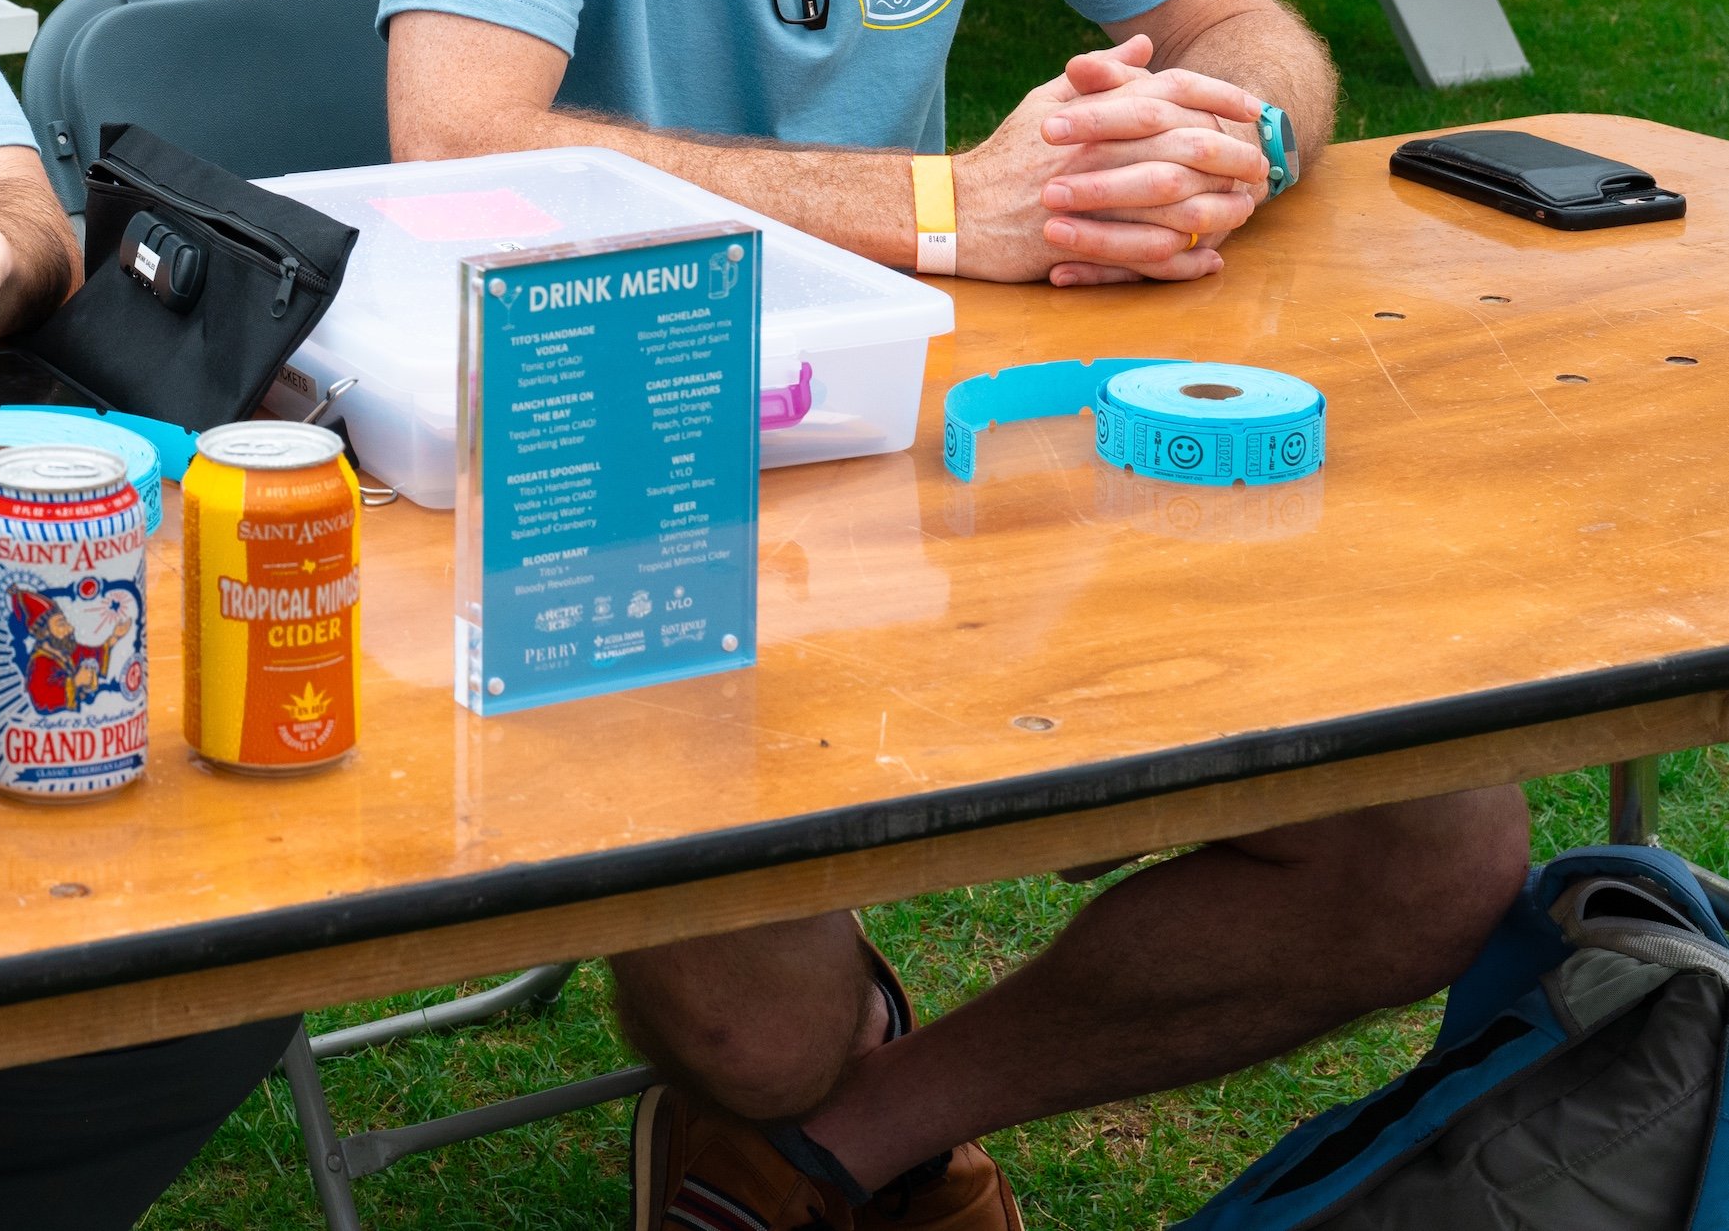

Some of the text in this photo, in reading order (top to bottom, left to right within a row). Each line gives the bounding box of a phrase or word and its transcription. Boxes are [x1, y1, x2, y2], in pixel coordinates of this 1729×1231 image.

[529, 262, 699, 313] DRINK MENU
[657, 307, 711, 324] MICHELADA
[510, 324, 595, 346] TITO'S HANDMADE
[637, 320, 732, 341] Bloody Revolution mix
[535, 343, 569, 357] VODKA
[646, 332, 730, 356] your choice of Saint
[521, 362, 545, 372] Tonic
[546, 360, 557, 369] or
[655, 350, 712, 366] Arnold's Beer
[280, 366, 308, 392] ICKETS
[517, 370, 585, 388] Sparkling Water
[646, 370, 723, 391] CIAO! SPARKLING
[511, 391, 594, 412] RANCH WATER ON
[648, 384, 721, 404] WATER FLAVORS
[533, 408, 571, 423] THE BAY
[653, 405, 679, 417] Blood
[652, 415, 713, 430] Peach, Cherry,
[509, 428, 541, 441] Tequila
[548, 424, 570, 435] Lime
[664, 430, 702, 443] and Lime
[517, 435, 585, 454] Sparkling Water
[1136, 426, 1146, 467] 010242
[1154, 431, 1162, 466] SMILE
[672, 452, 695, 465] WINE
[1219, 437, 1230, 473] 010242
[1249, 437, 1259, 474] 010241
[507, 461, 601, 485] ROSEATE SPOONBILL
[670, 466, 693, 479] LYLO
[519, 477, 592, 496] Tito's Handmade
[646, 478, 715, 497] Sauvignon Blanc
[514, 500, 541, 512] Vodka
[549, 495, 570, 506] Lime
[673, 501, 696, 514] BEER
[518, 506, 585, 525] Sparkling Water
[660, 514, 709, 529] Grand Prize
[239, 520, 297, 541] SAINT
[511, 519, 597, 540] Splash of Cranberry
[658, 527, 710, 543] Lawnmower
[522, 546, 589, 566] BLOODY MARY
[661, 540, 708, 557] Art Car IPA
[638, 550, 730, 573] Tropical Mimosa Cider
[220, 566, 360, 620] TROPICAL MIMOS
[515, 575, 594, 596] Bloody Revolution
[665, 597, 693, 611] LYLO
[268, 618, 342, 647] CIDER
[661, 623, 679, 636] SAINT
[525, 642, 578, 664] PERRY
[5, 710, 146, 765] GRAND PRIZE
